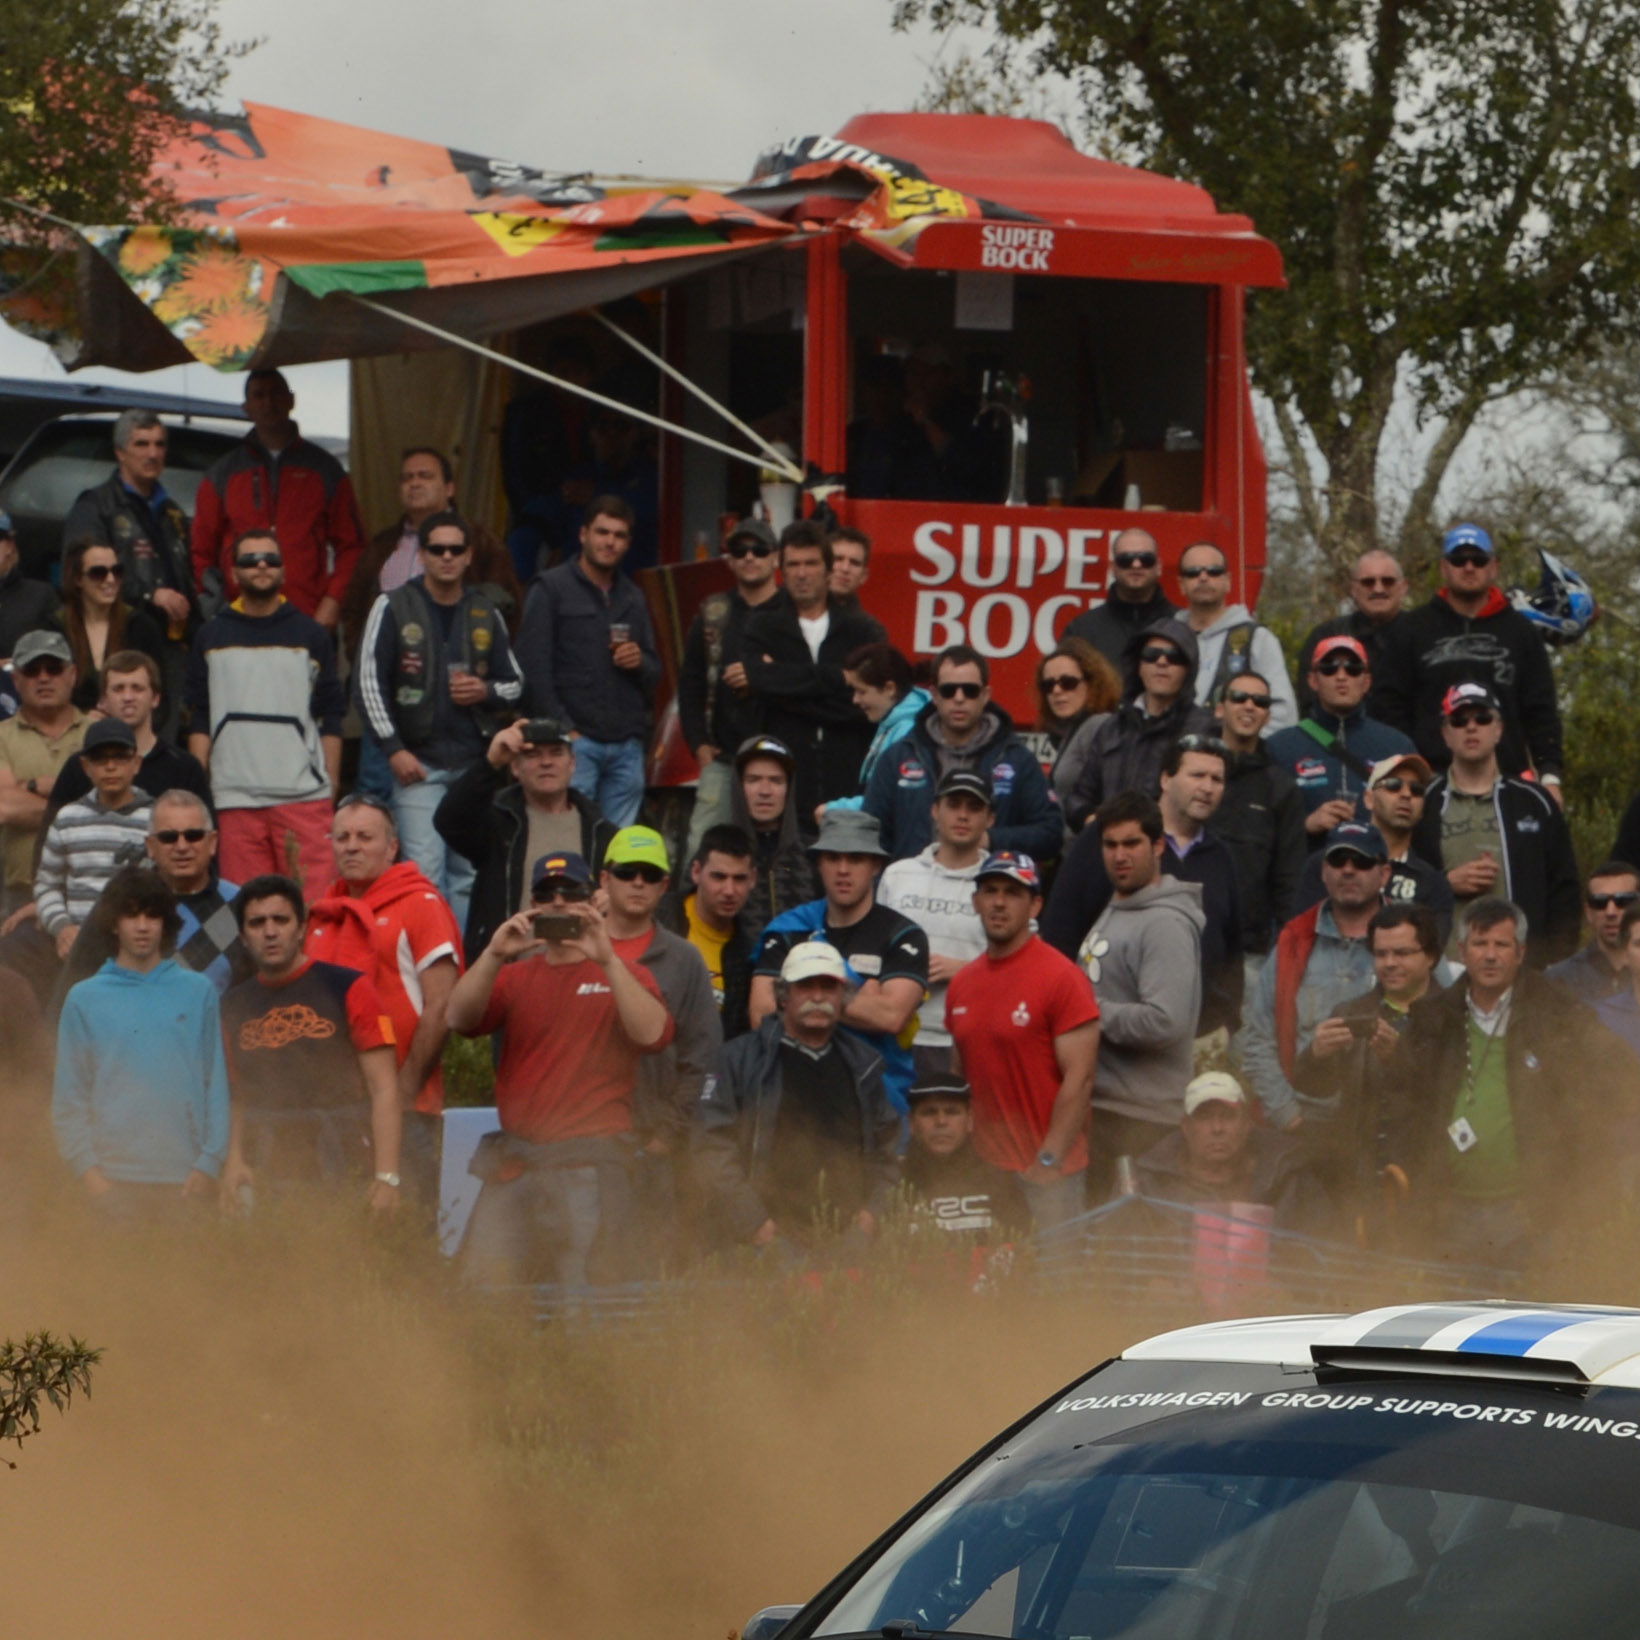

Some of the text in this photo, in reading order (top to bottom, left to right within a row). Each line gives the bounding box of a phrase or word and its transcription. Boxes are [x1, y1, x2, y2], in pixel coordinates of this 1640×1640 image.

[981, 225, 1055, 251] SUPER
[981, 246, 1050, 271] BOCK
[908, 520, 1120, 591] SUPE
[912, 589, 1107, 659] BOC
[1390, 874, 1417, 899] 78
[1055, 1391, 1252, 1414] VOLKSWAGEN
[1261, 1393, 1375, 1413] GROUP
[1375, 1397, 1538, 1425] SUPPORTS
